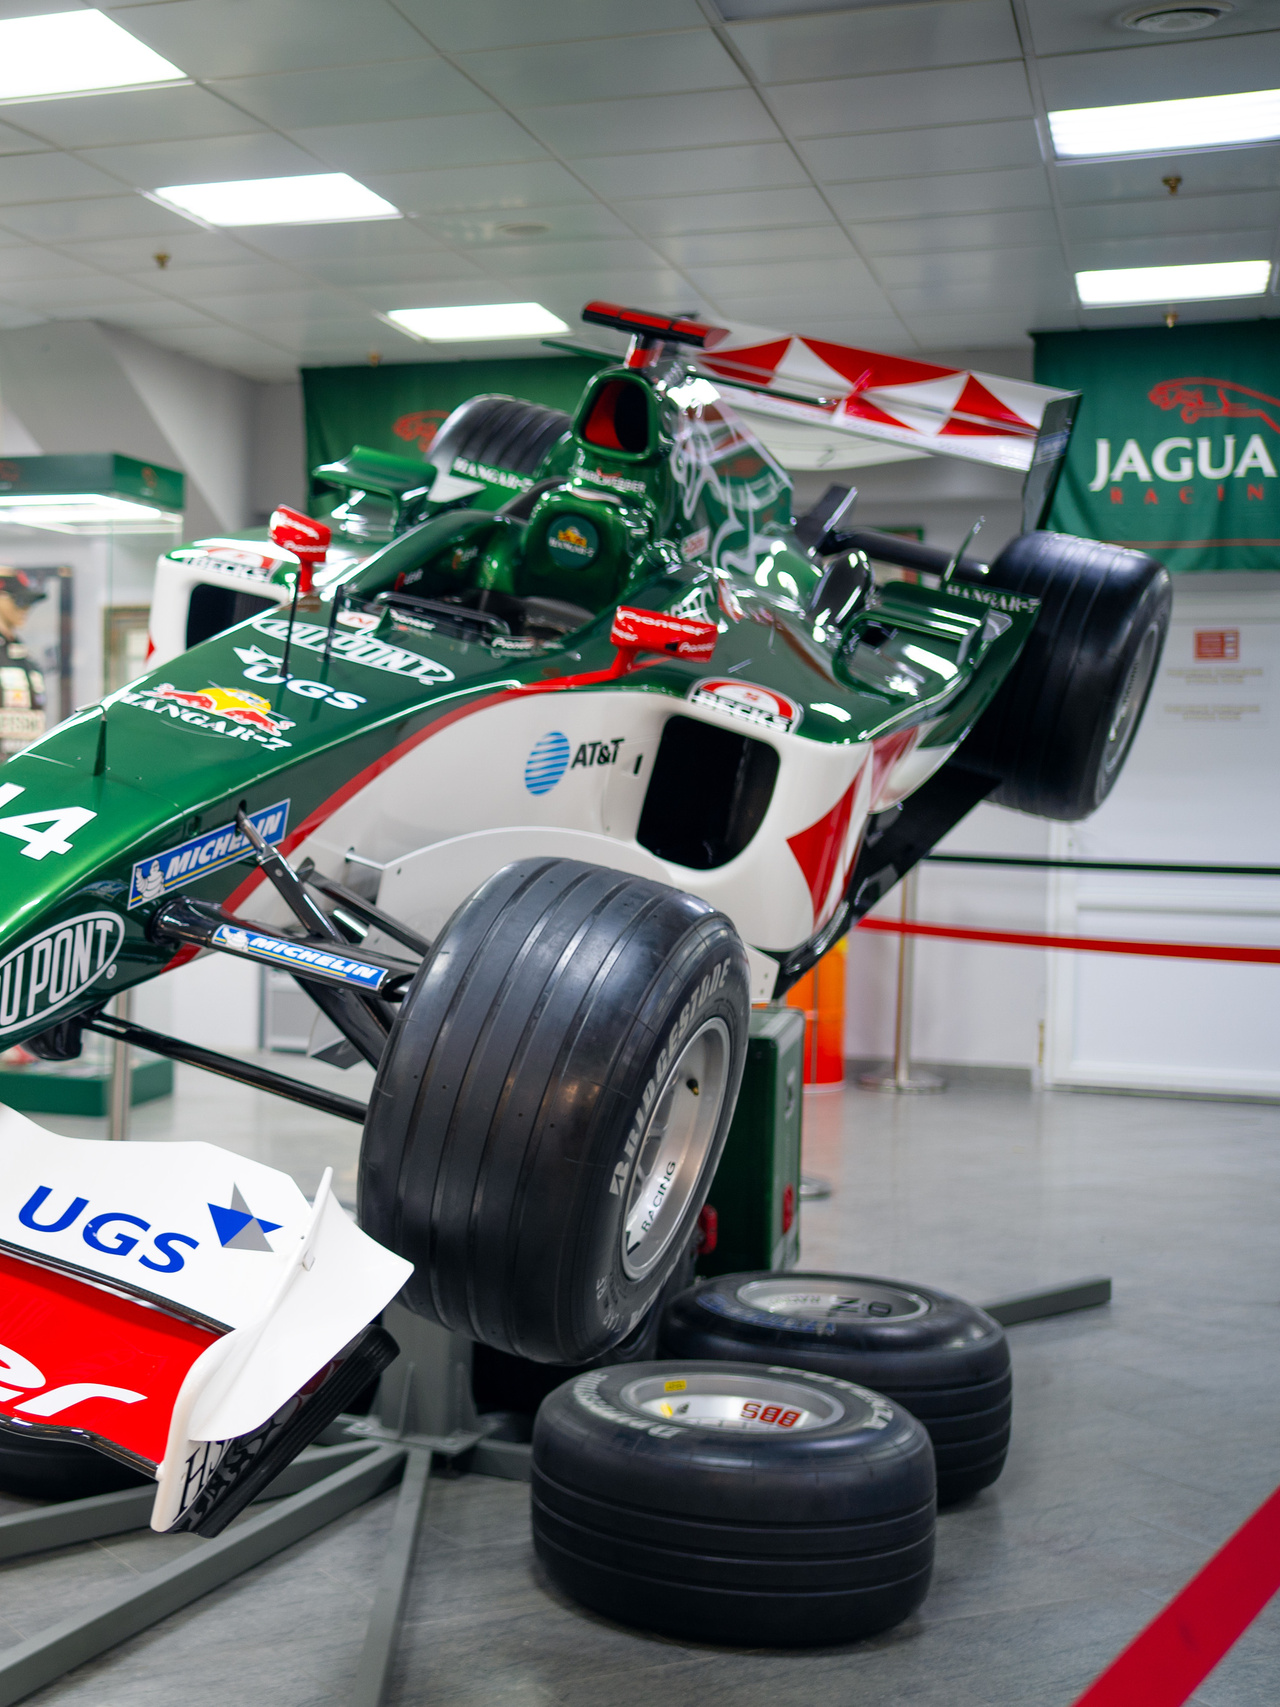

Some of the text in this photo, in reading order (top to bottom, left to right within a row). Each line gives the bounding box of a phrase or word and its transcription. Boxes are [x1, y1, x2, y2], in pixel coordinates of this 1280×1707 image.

[1087, 433, 1279, 493] JAGUA
[1109, 484, 1265, 505] RACIN
[570, 737, 625, 770] AT&T
[249, 936, 379, 980] MICHELIN
[640, 1160, 677, 1233] RACING
[18, 1184, 200, 1274] UGS
[740, 1401, 802, 1429] BBS
